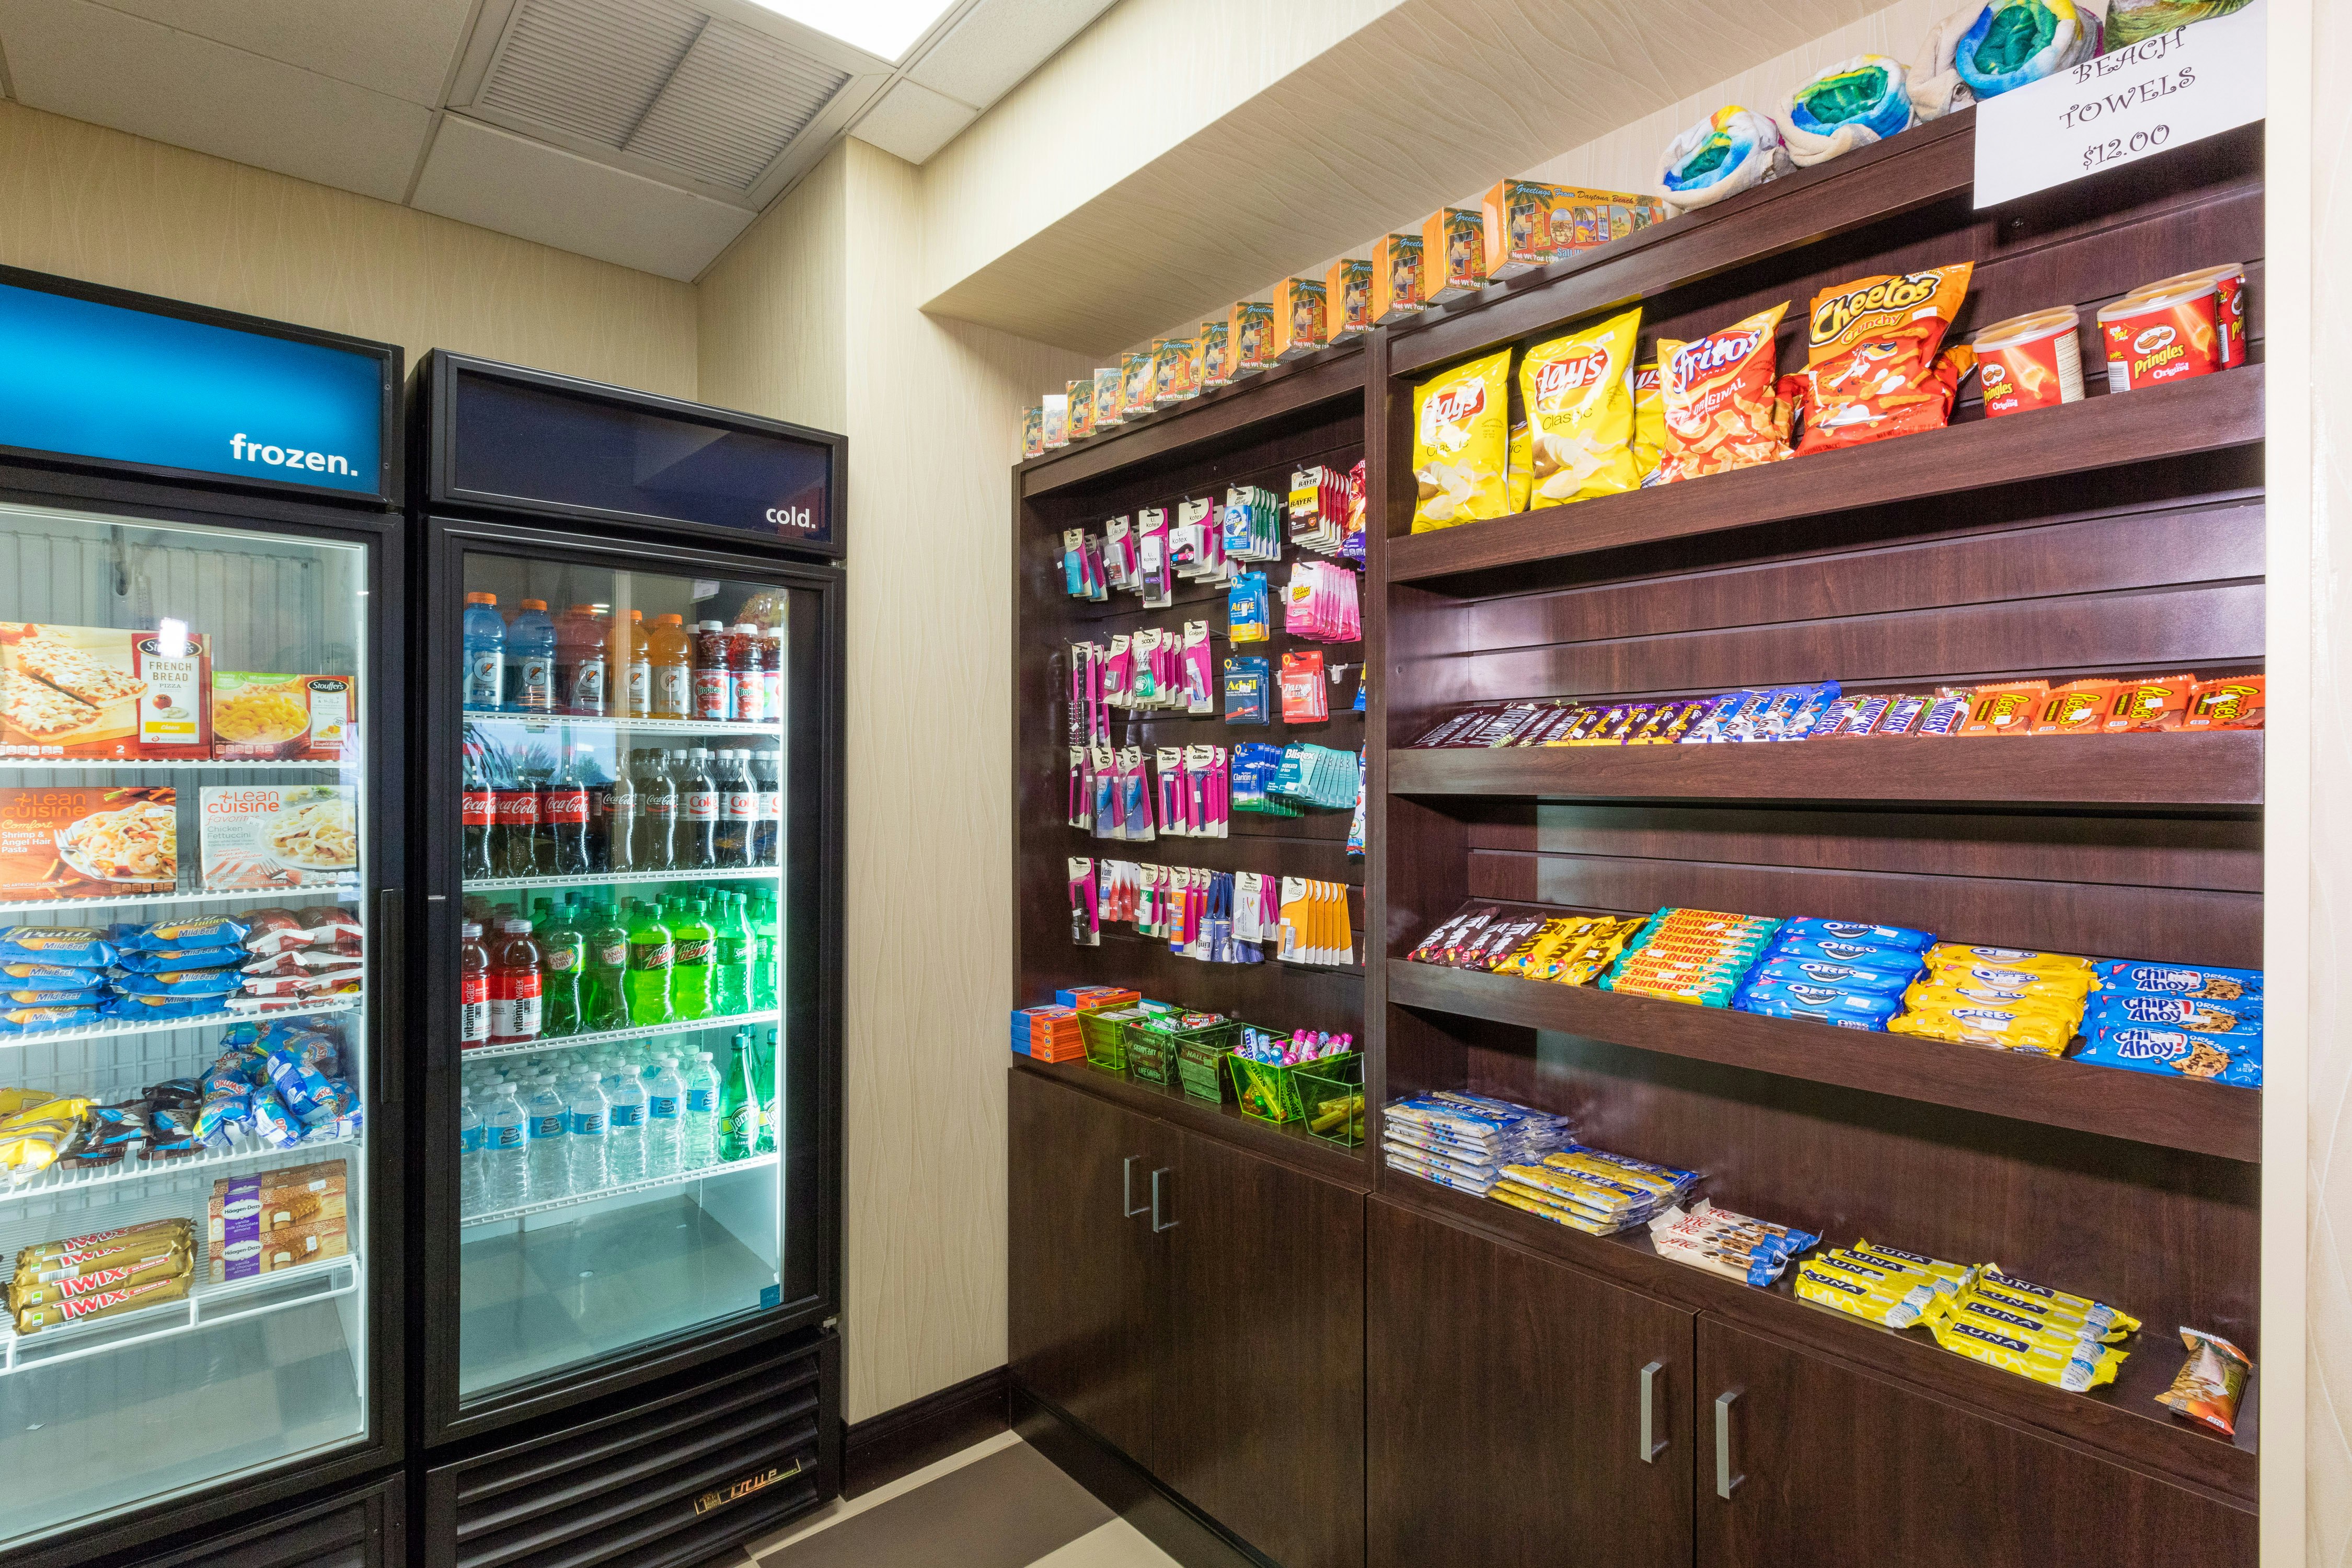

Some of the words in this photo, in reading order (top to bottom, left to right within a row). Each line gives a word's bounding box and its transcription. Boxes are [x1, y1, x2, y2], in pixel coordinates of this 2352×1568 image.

[2072, 25, 2187, 85] BEACH
[2059, 66, 2196, 129] TOWELS
[2083, 124, 2170, 170] $12.00
[1516, 184, 1551, 197] Greetings
[1553, 188, 1575, 198] From
[1577, 191, 1609, 202] Daytona
[1612, 195, 1634, 204] Beach
[1557, 248, 1573, 258] Salt
[1811, 275, 1936, 345] Cheetos
[1841, 313, 1904, 344] Crunchy
[2114, 330, 2127, 340] go!
[1671, 329, 1761, 394] Fritos
[2134, 342, 2185, 378] Pringles
[1698, 368, 1726, 381] BRAND
[2153, 362, 2189, 379] Original
[1538, 354, 1605, 401] Lay's
[1694, 377, 1746, 414] ORIGINAL
[1984, 382, 2013, 405] Pringles
[1992, 399, 2018, 410] Original
[1542, 406, 1593, 431] Classic
[229, 433, 358, 476] frozen.
[1298, 478, 1317, 487] BAYER
[1290, 497, 1312, 508] BAYER
[766, 506, 815, 528] cold.
[1226, 517, 1241, 525] Seltzer
[1294, 590, 1310, 600] Bismol
[149, 662, 192, 671] FRENCH
[153, 673, 188, 681] BREAD
[313, 682, 344, 690] Stouffer's
[1285, 748, 1315, 762] Blistex
[235, 791, 279, 802] Lean
[689, 796, 717, 807] Coke
[546, 796, 588, 813] Coca-Cola
[2, 820, 53, 830] Comfort
[1676, 908, 1745, 921] Starburst
[178, 929, 200, 937] Mild
[200, 926, 219, 935] Beef
[1822, 922, 1882, 930] OREO
[1652, 941, 1720, 956] Starburst
[1817, 942, 1877, 953] OREO
[548, 953, 575, 965] CANADA
[611, 954, 624, 962] DRY
[1800, 963, 1858, 975] OREO
[1620, 976, 1689, 992] Starburst
[2203, 973, 2246, 984] ORIGINAL
[1786, 985, 1848, 995] OREO
[36, 993, 59, 1001] Mild
[2124, 998, 2180, 1010] Chips
[2196, 1001, 2240, 1014] ORIGINAL
[1952, 1009, 2018, 1019] OREO
[2189, 1035, 2232, 1053] ORIGINAL
[1445, 1109, 1474, 1119] Butter
[1844, 1250, 1898, 1270] LUNA
[1872, 1246, 1924, 1262] LUNA
[52, 1267, 126, 1298] TWIX
[1806, 1271, 1858, 1292] LUNA
[1987, 1272, 2046, 1295] LUNA
[1970, 1304, 2034, 1327] LUNA
[1954, 1323, 2019, 1350] LUNA
